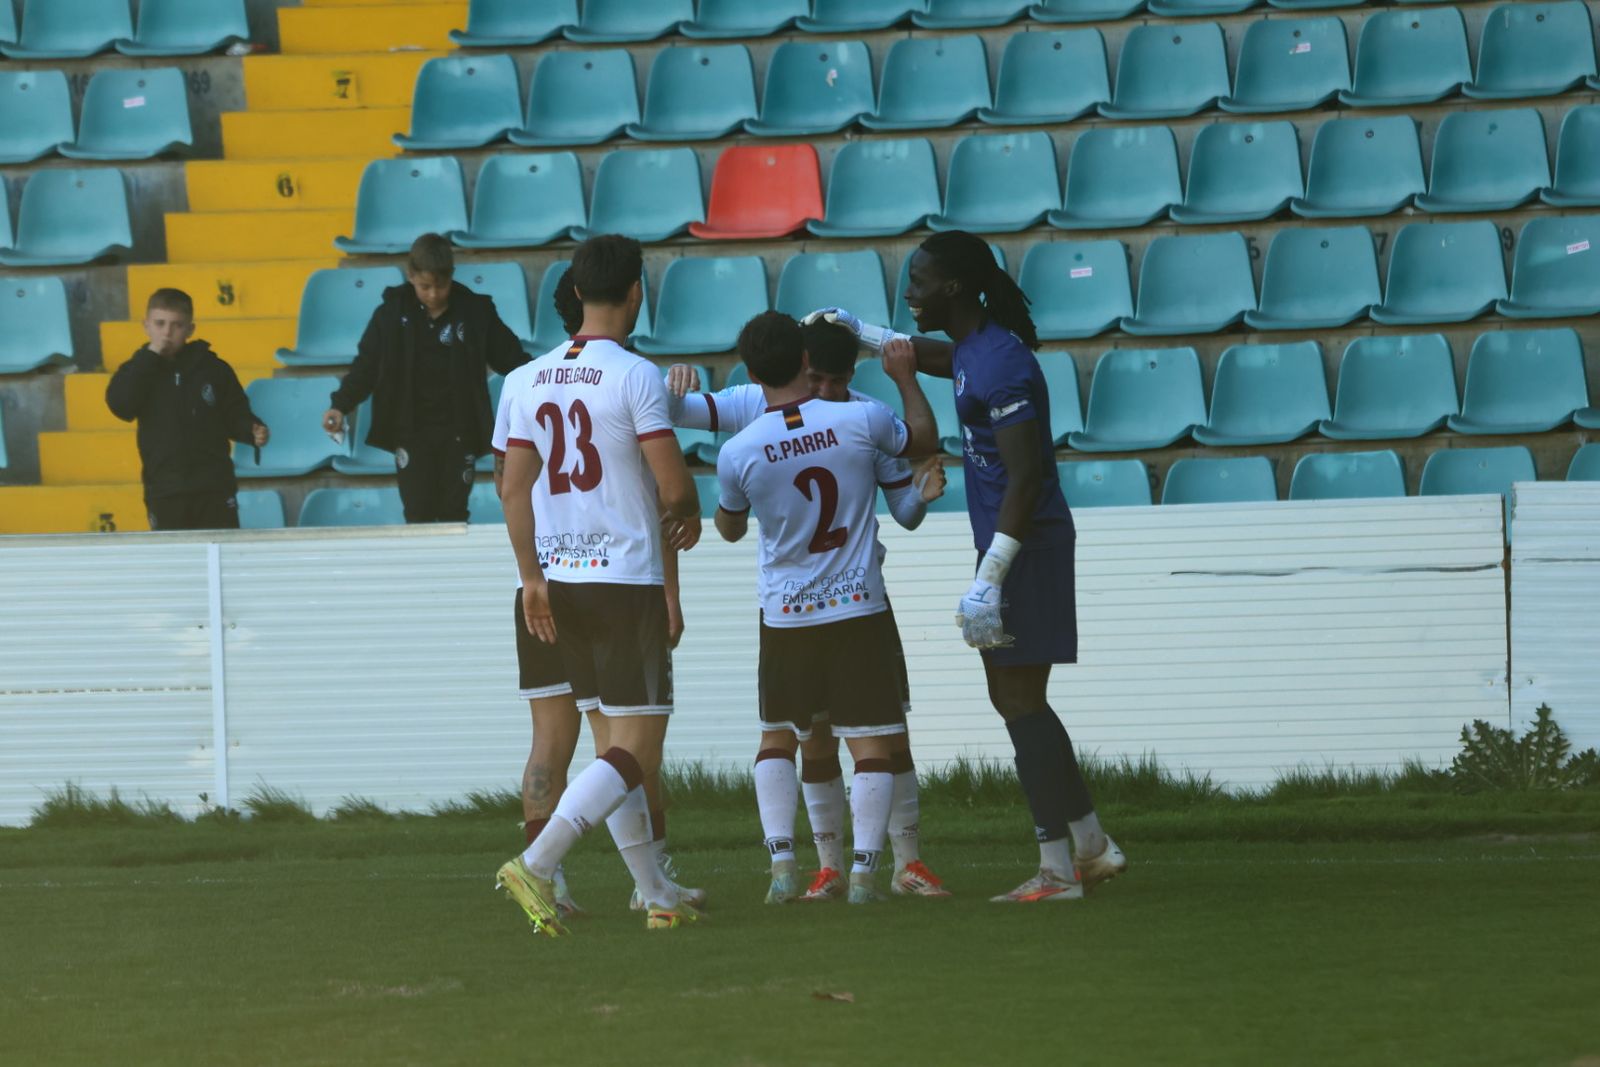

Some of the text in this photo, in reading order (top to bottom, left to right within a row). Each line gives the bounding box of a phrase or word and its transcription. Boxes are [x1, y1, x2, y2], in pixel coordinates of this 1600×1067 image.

[276, 173, 294, 198] 6
[1374, 232, 1388, 255] 7
[1502, 227, 1515, 250] 9
[532, 367, 603, 388] AVI DELGADO
[535, 398, 603, 496] 23
[763, 428, 839, 464] C.PARRA
[793, 466, 848, 555] 2
[782, 581, 869, 605] EMPRESARIAL
